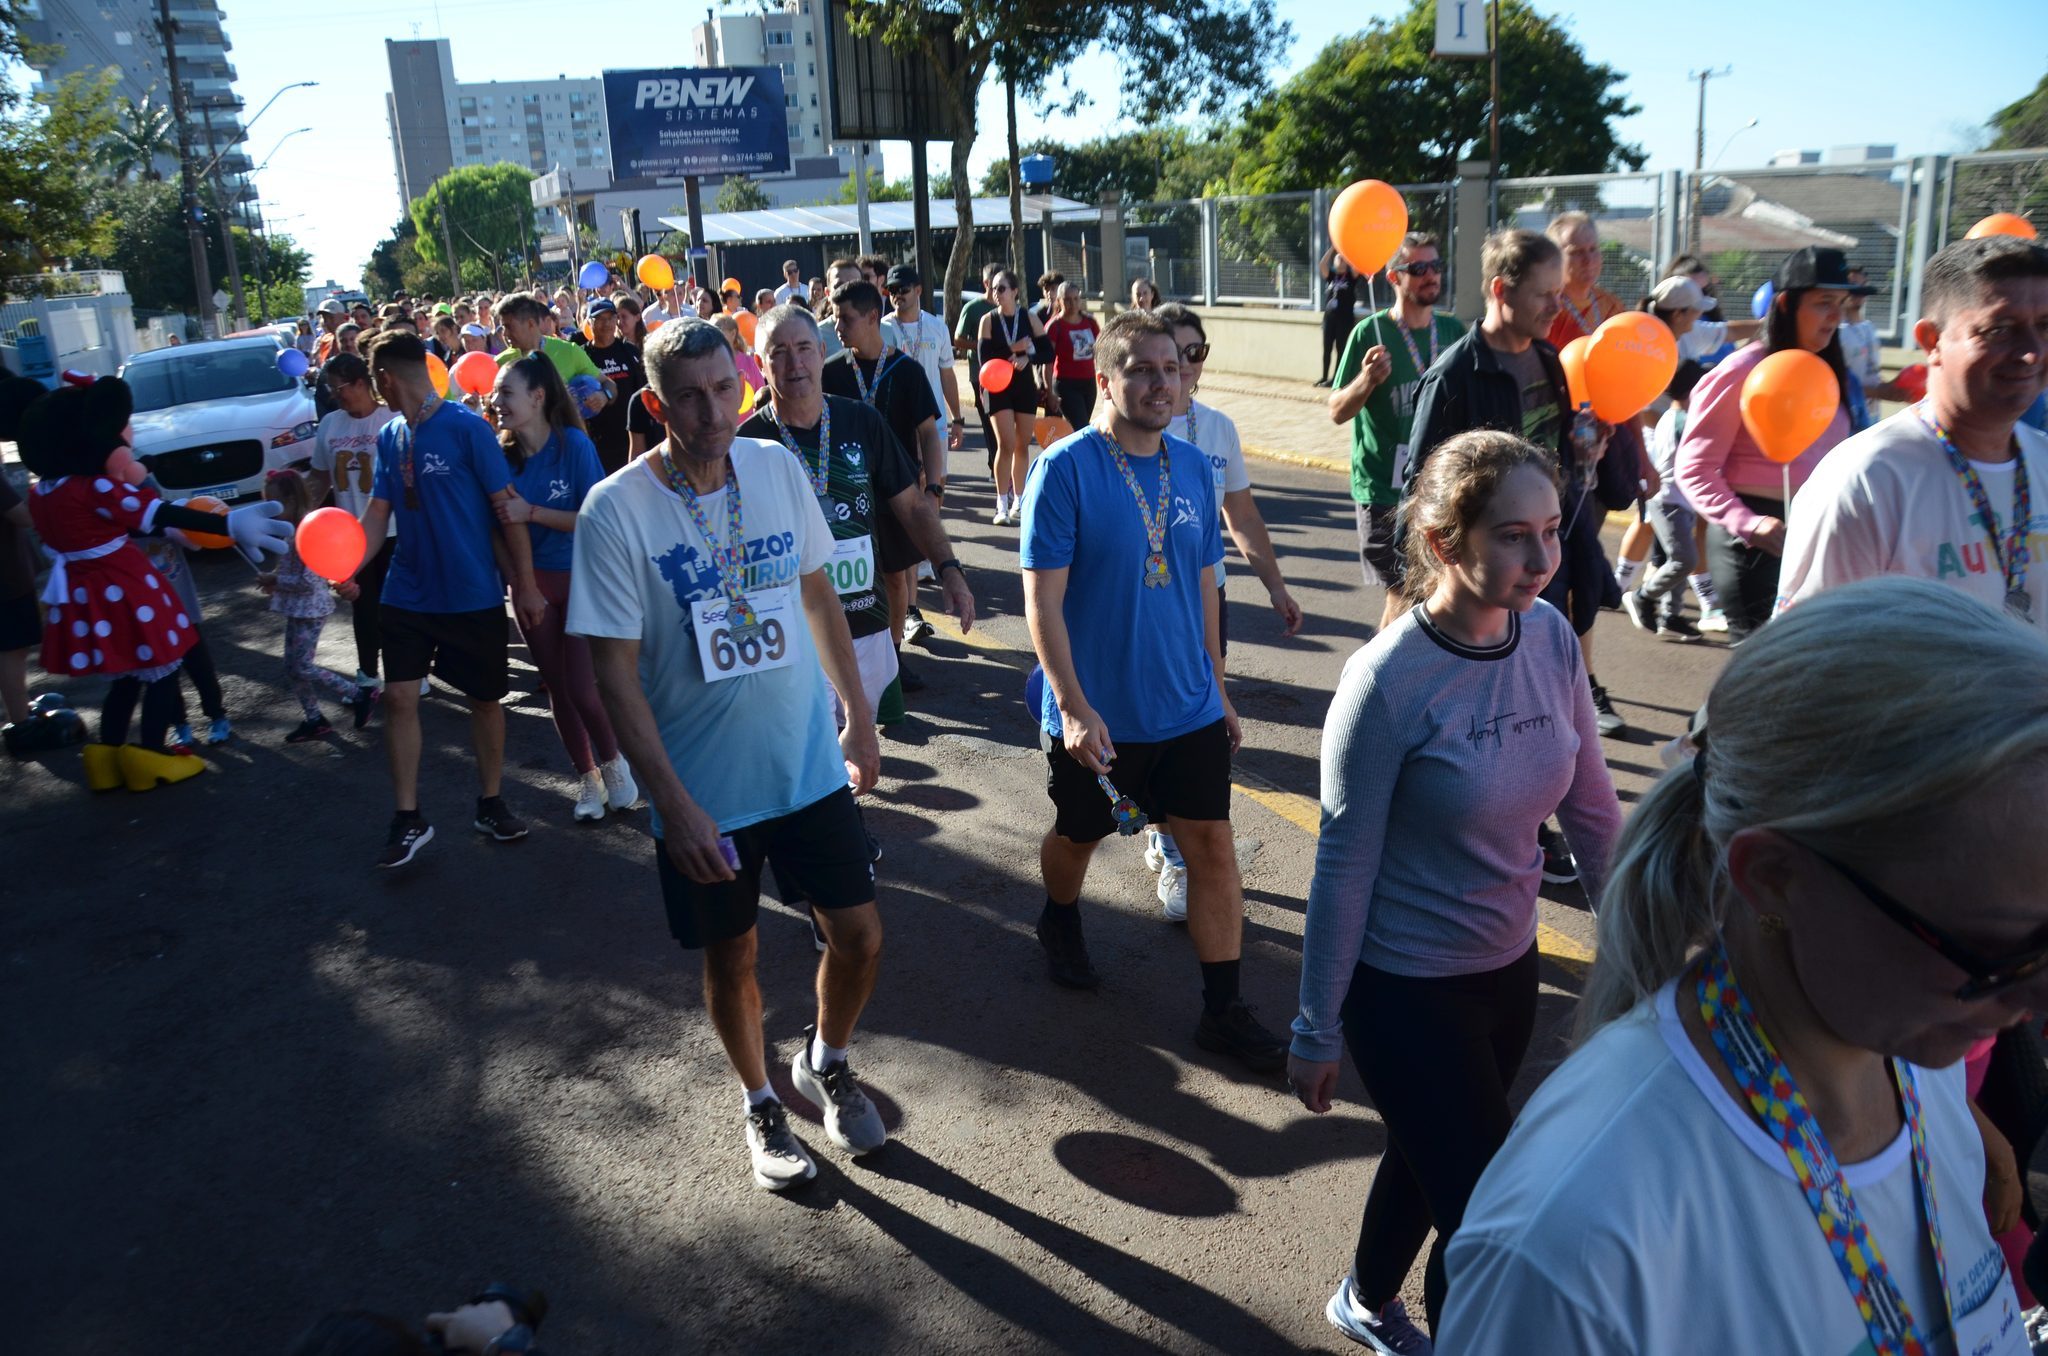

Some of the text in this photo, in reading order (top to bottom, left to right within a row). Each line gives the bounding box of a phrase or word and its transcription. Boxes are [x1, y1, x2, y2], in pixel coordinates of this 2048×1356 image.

[635, 76, 755, 109] PBNEW
[666, 107, 758, 122] SISTEMAS
[659, 127, 739, 138] Soluções tecnológicas
[672, 136, 704, 148] produtos
[638, 157, 680, 168] pbnew.com.br
[711, 618, 785, 671] 669
